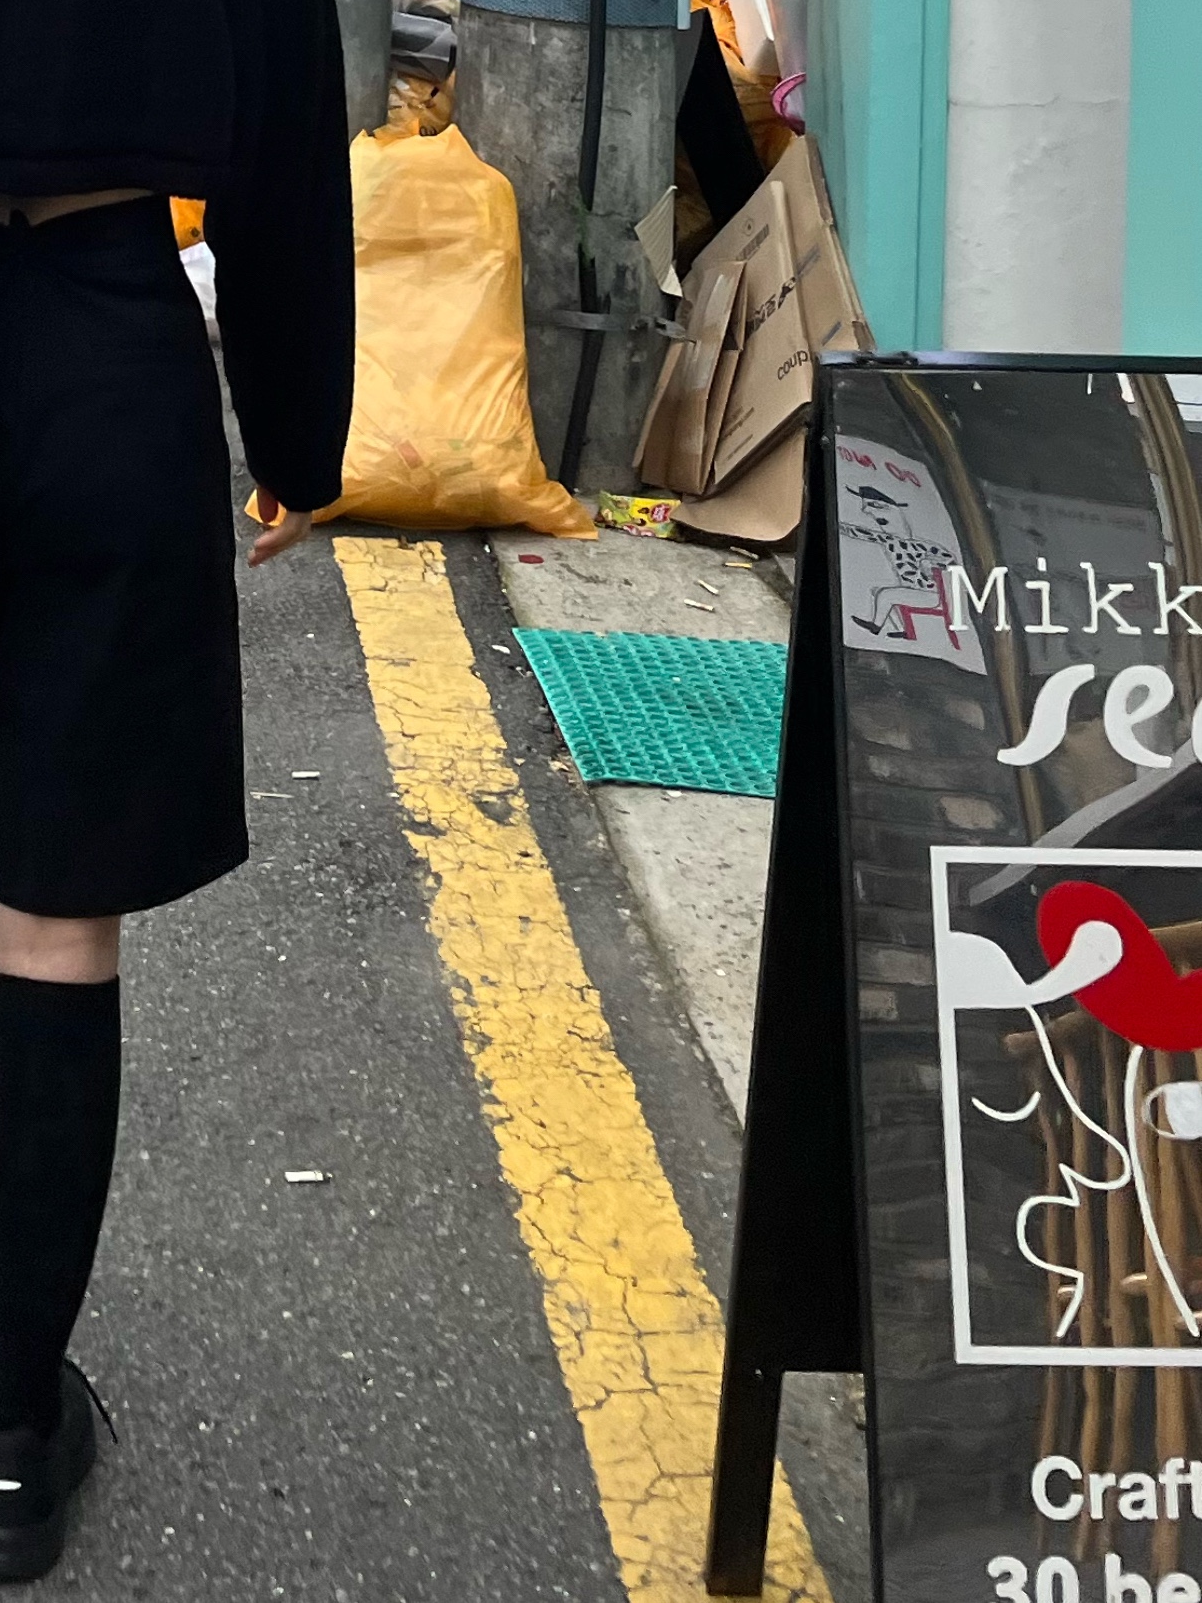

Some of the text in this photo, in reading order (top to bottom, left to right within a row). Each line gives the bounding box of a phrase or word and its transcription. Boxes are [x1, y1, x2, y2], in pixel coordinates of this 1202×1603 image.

[947, 557, 1202, 635] Mikk
[996, 664, 1202, 769] se
[1031, 1455, 1202, 1521] Craft
[987, 1556, 1080, 1603] 30
